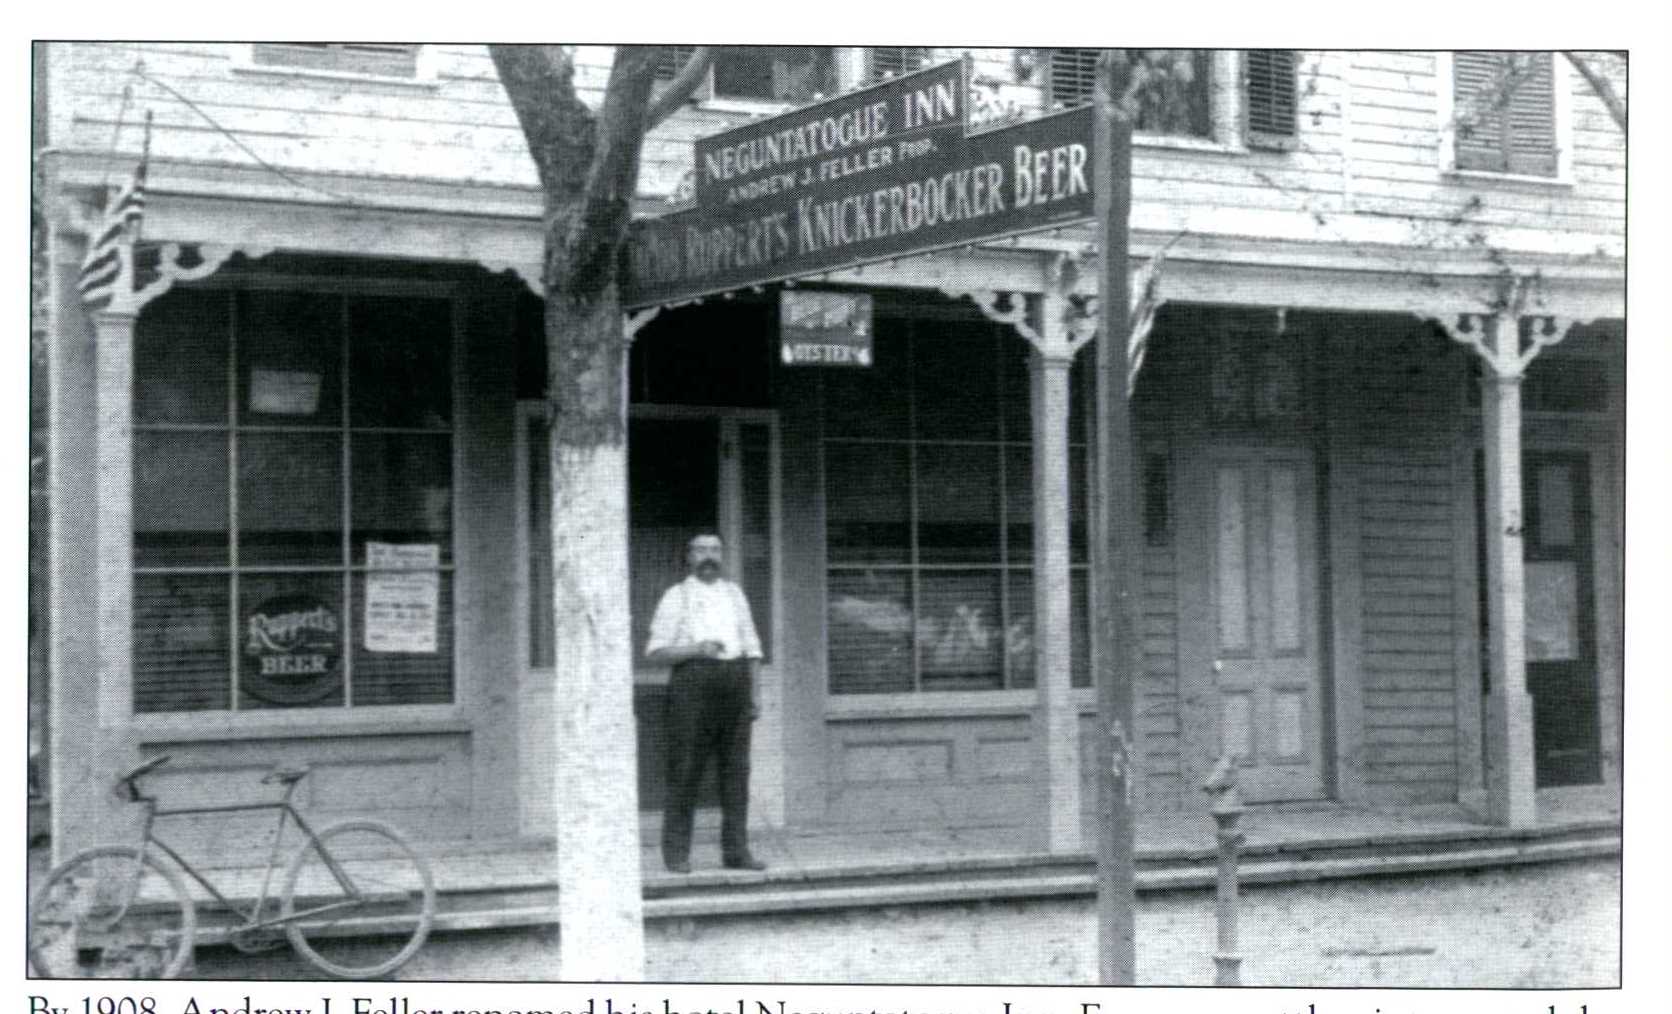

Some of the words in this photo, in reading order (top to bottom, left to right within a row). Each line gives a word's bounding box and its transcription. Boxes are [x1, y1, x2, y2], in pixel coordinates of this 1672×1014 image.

[704, 102, 888, 184] NEGUNTATOGUE
[904, 80, 955, 129] INN
[727, 171, 796, 202] ANDREW
[820, 145, 893, 182] FELLER
[799, 162, 1005, 252] KNICKERBOCKER
[1014, 143, 1089, 209] BEER
[261, 655, 328, 675] BEER
